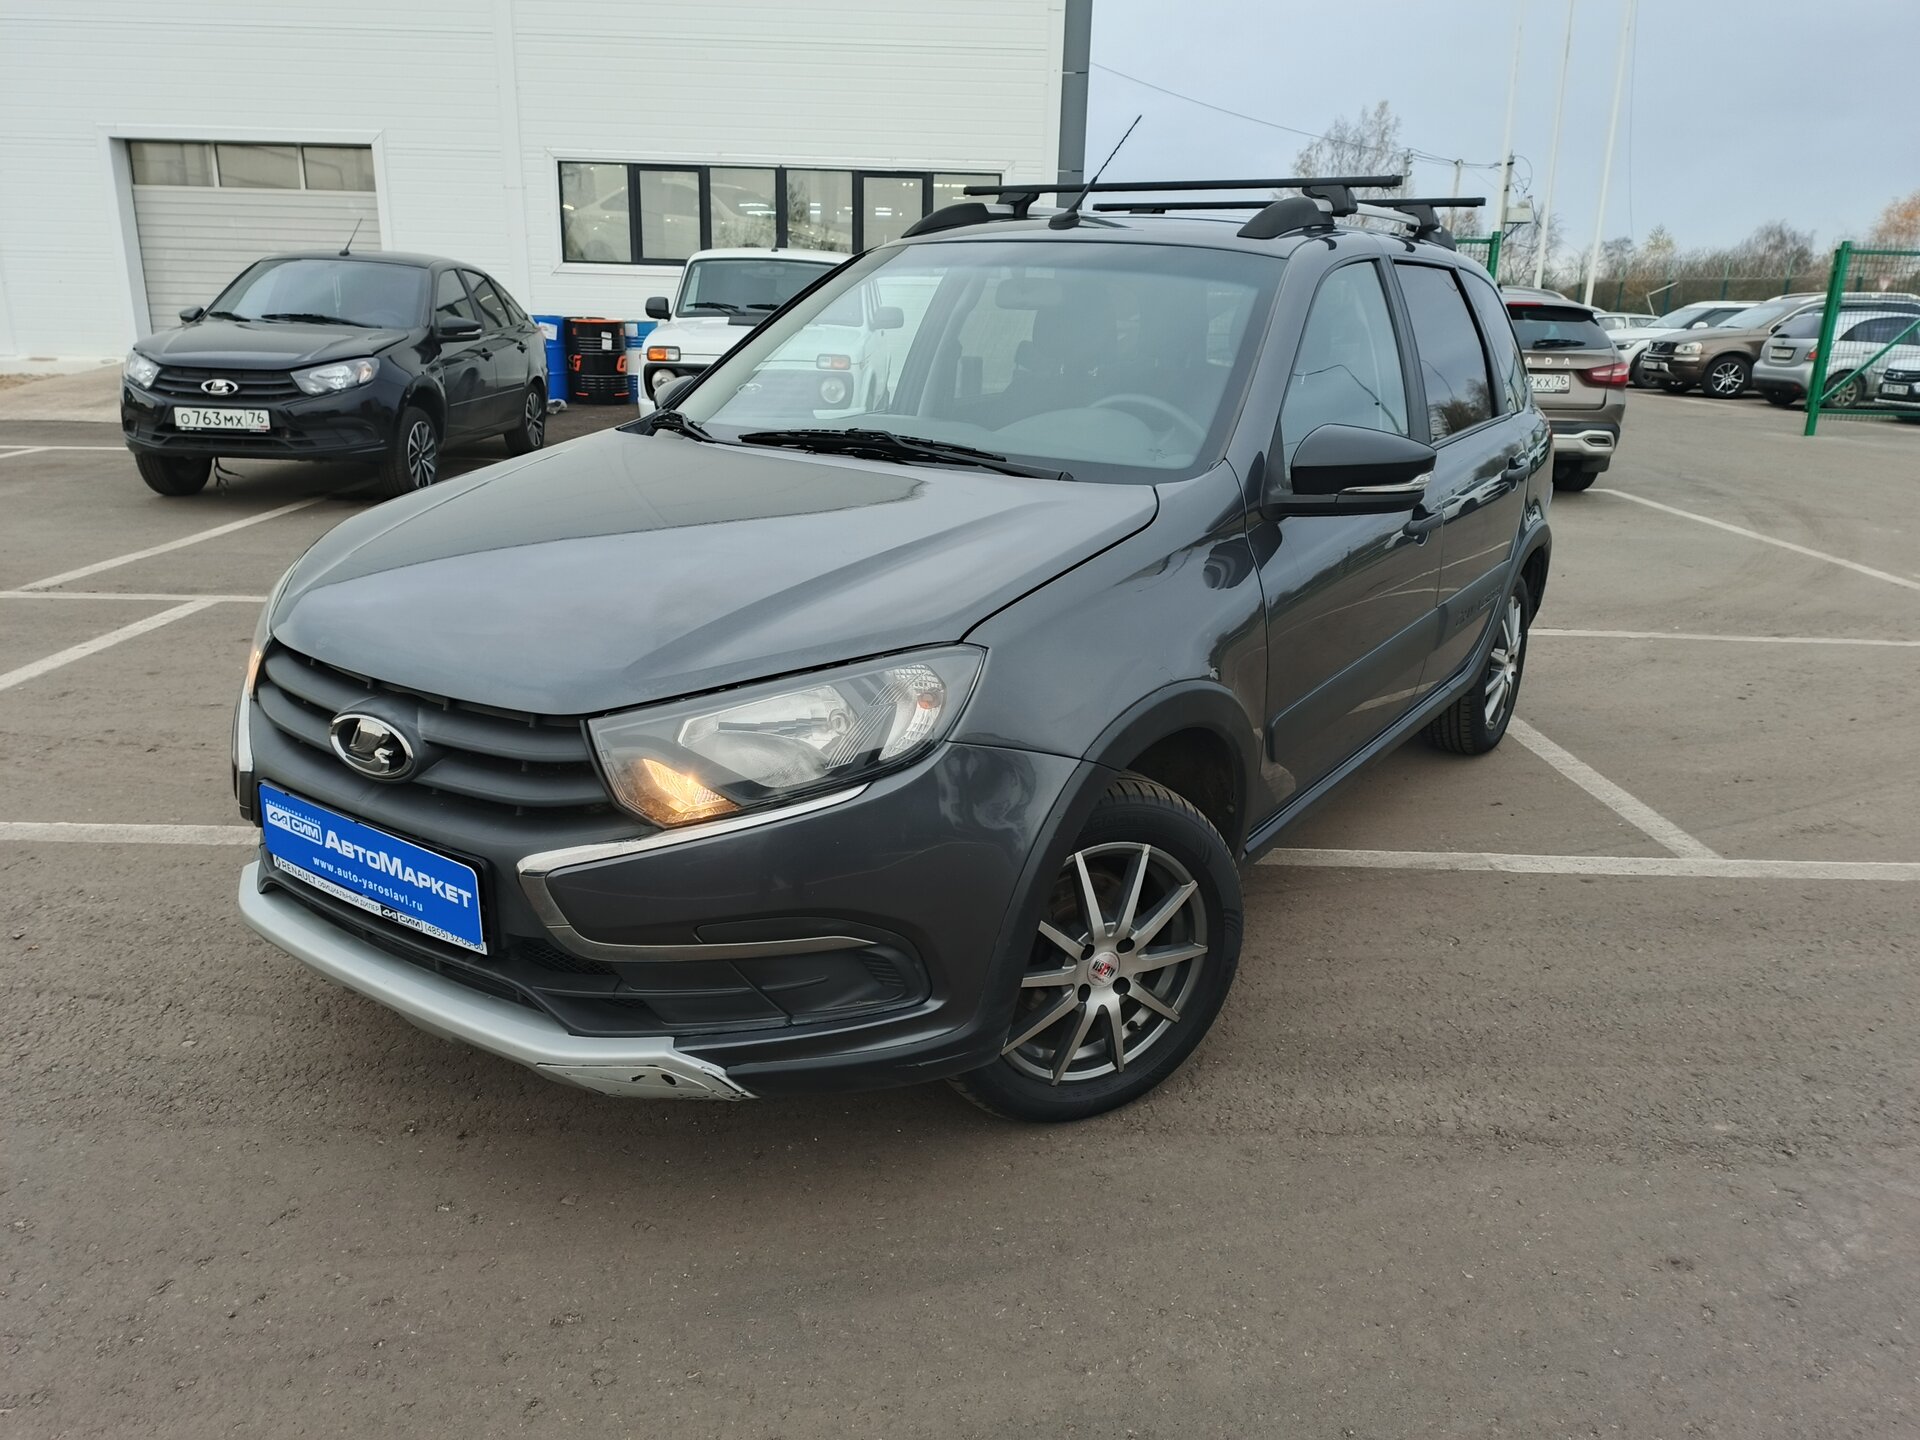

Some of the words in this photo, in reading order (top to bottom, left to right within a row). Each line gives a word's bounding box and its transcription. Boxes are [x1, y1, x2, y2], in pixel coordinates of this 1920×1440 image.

[1525, 357, 1570, 365] ADA
[292, 821, 319, 841] СИМ
[281, 860, 316, 885] RENAULT
[312, 856, 424, 912] www.auto-yaroslavl.ru
